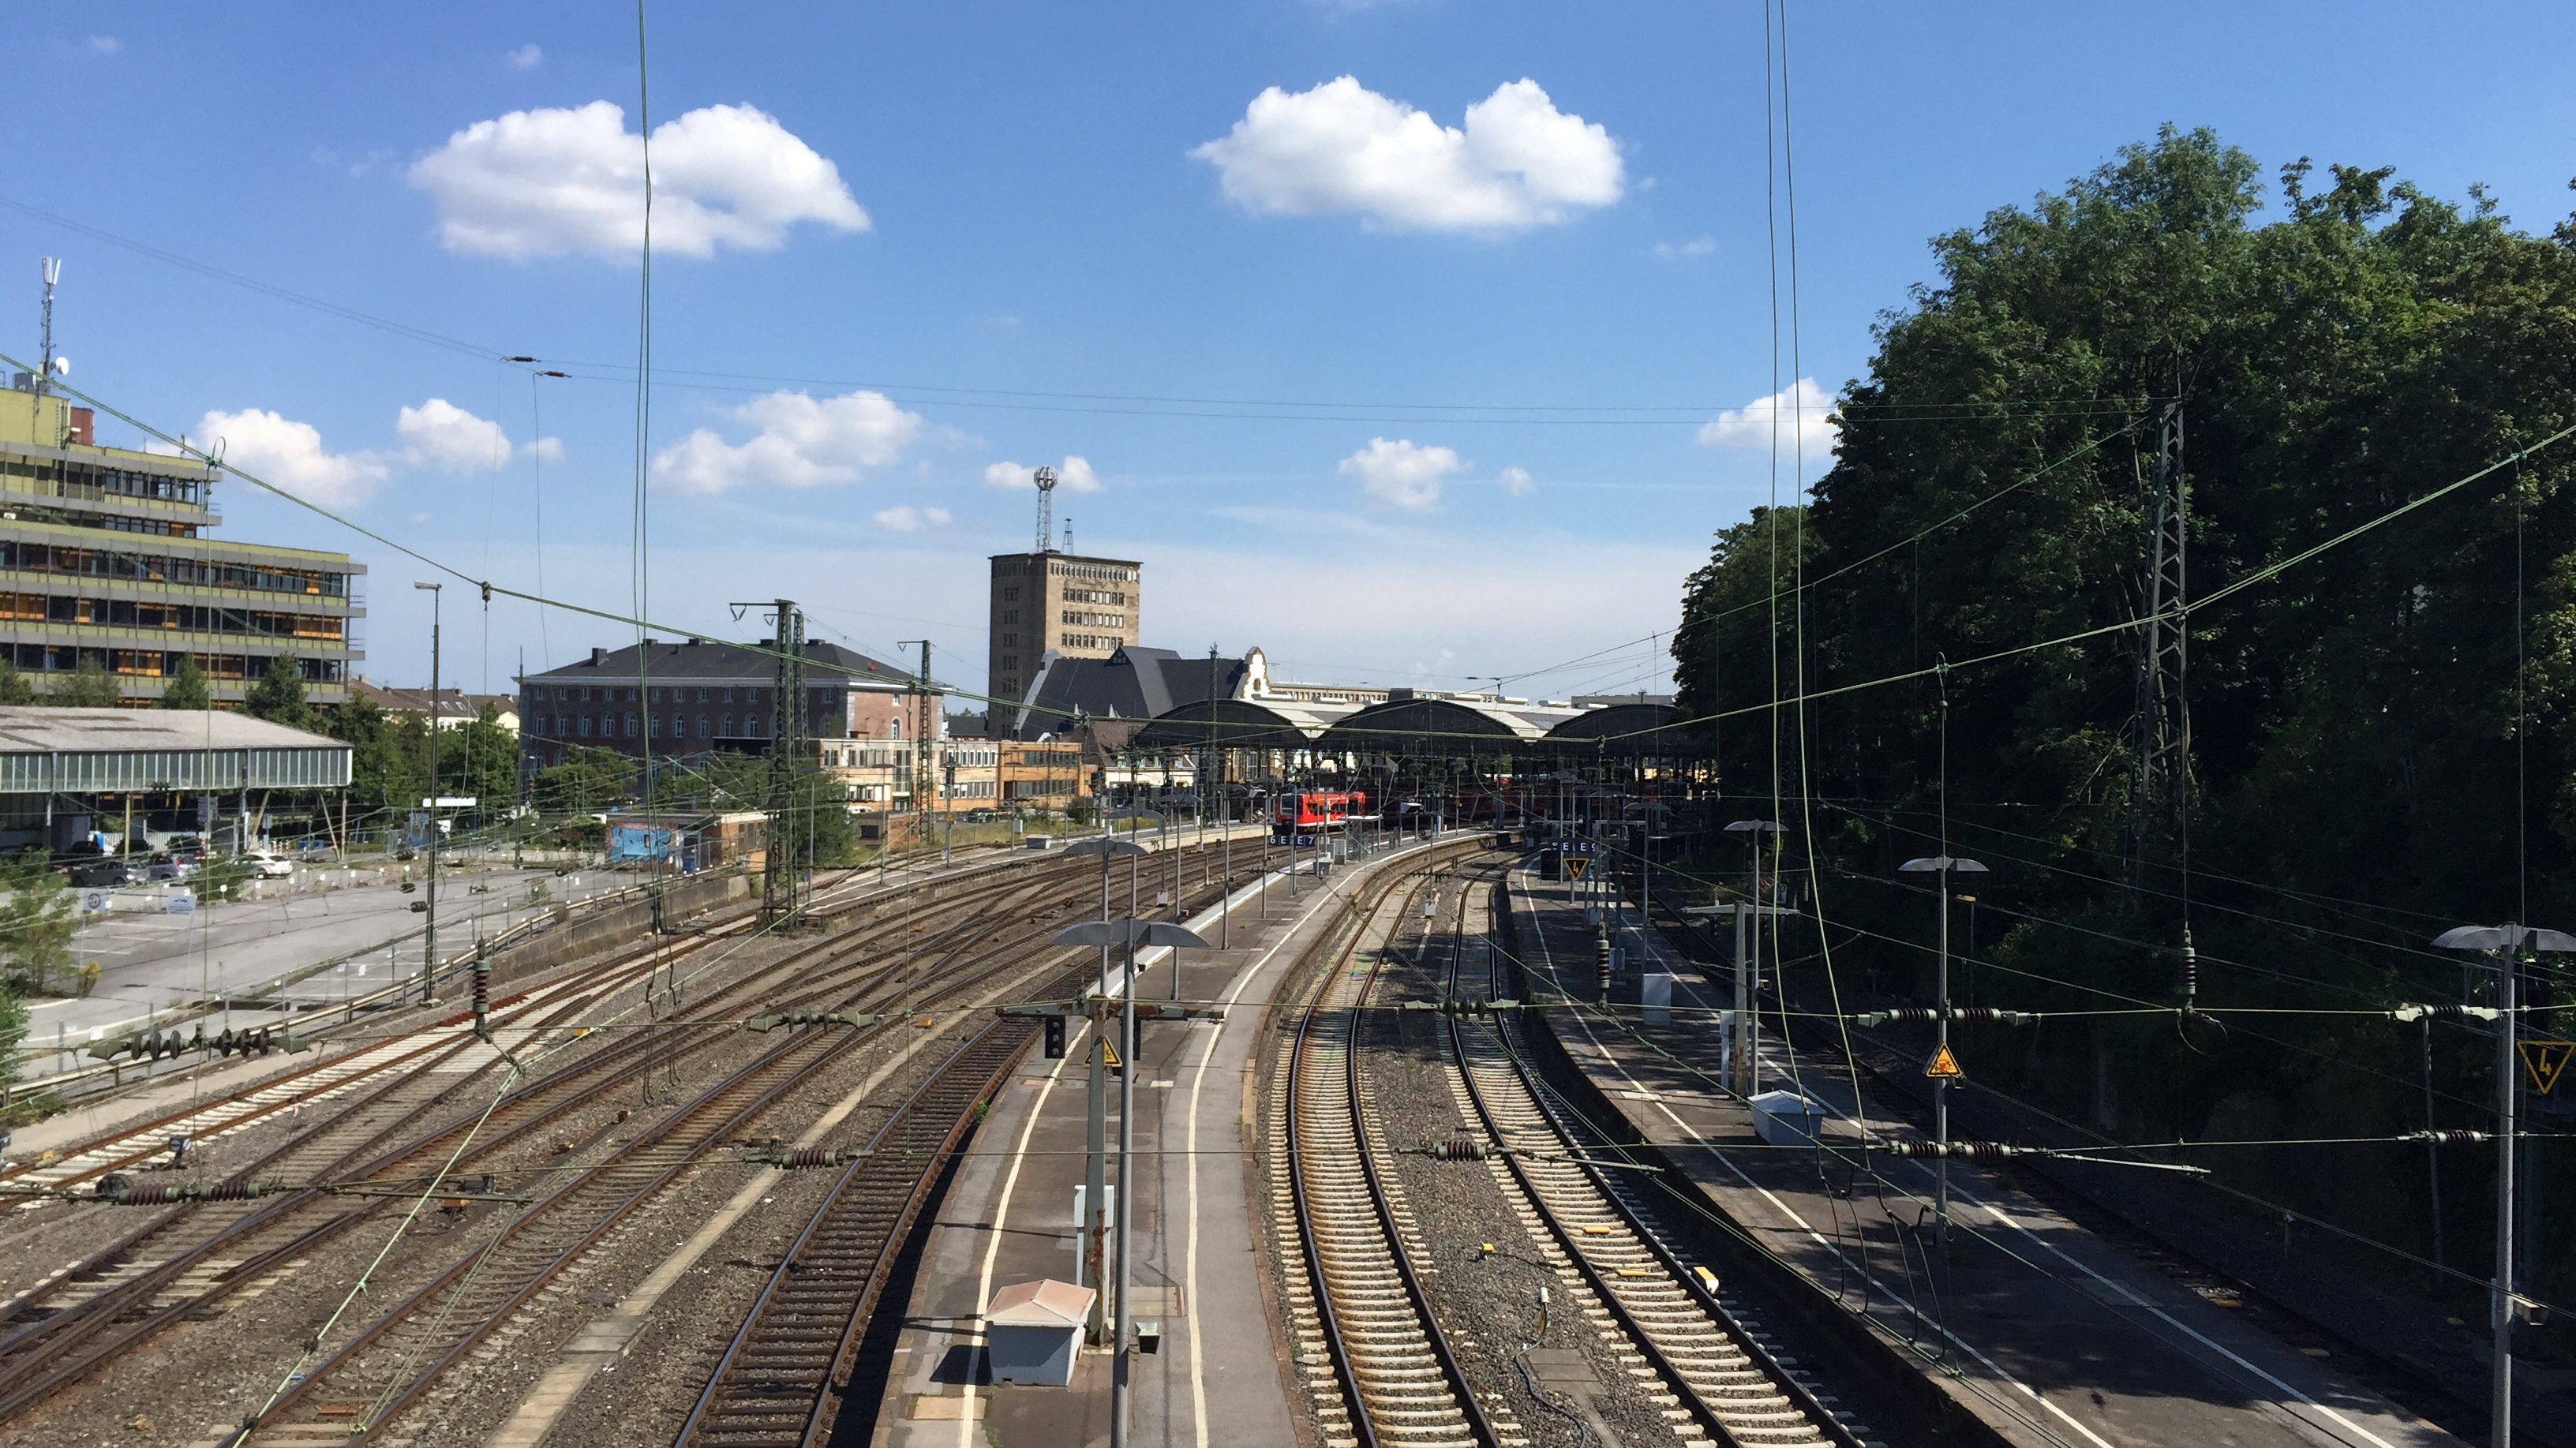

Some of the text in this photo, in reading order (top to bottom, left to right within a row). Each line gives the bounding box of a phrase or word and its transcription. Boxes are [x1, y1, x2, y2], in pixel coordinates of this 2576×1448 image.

[1281, 836, 1286, 844] E
[1297, 836, 1303, 844] E
[1563, 842, 1569, 851] E
